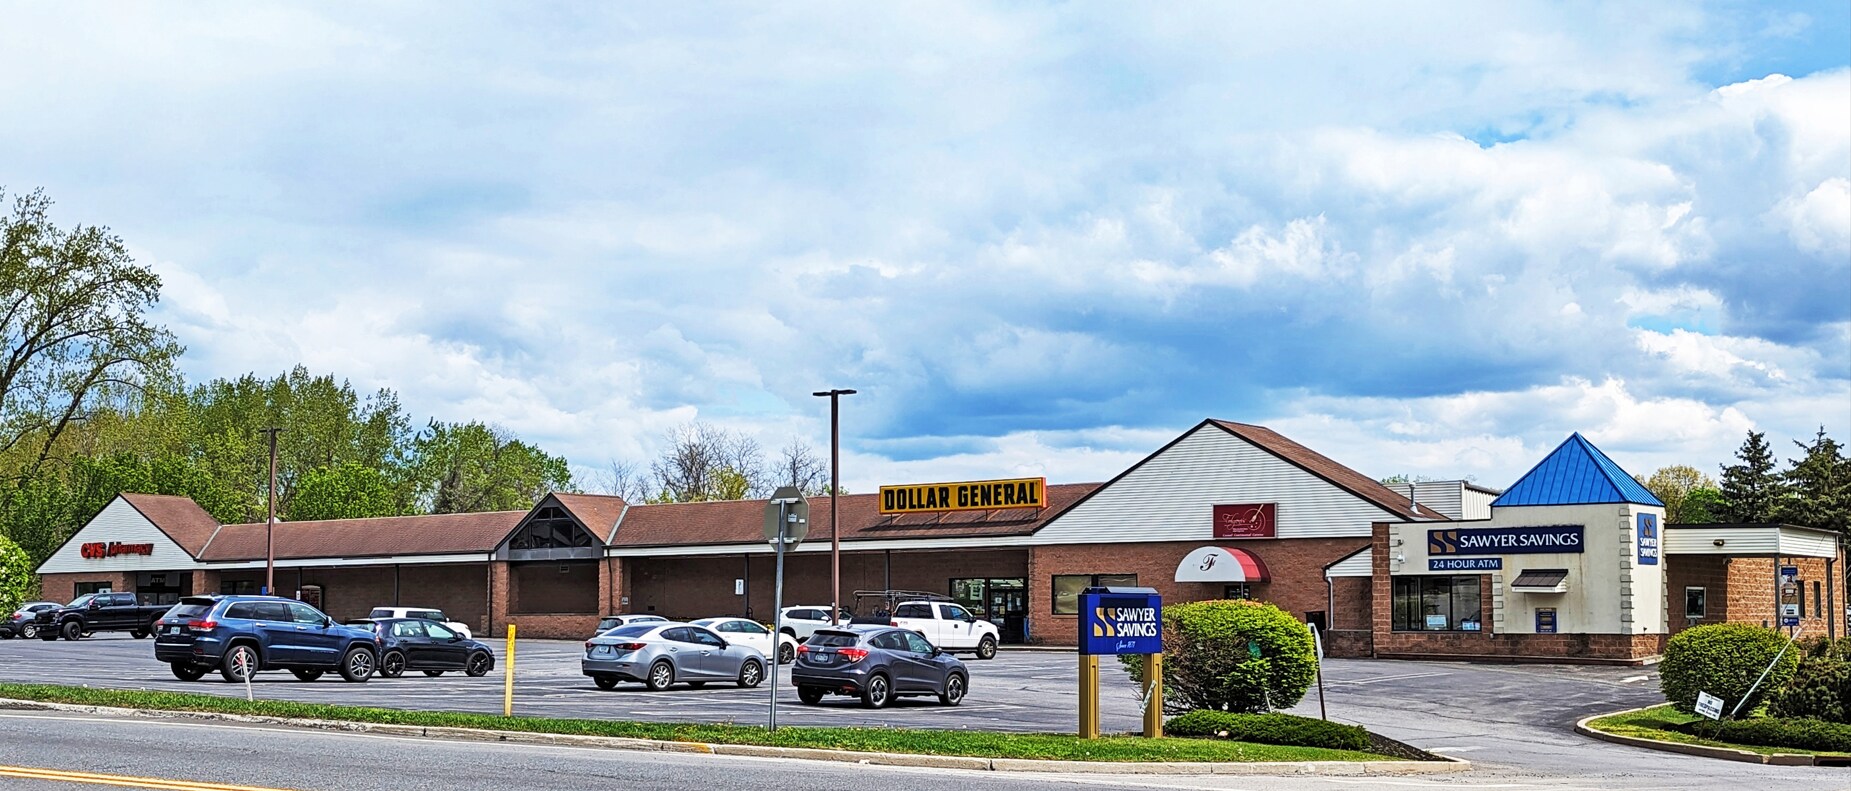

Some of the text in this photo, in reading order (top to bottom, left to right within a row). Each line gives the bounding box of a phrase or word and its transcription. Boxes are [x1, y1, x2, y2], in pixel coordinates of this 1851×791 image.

[884, 482, 1038, 510] DOLLAR GENERAL
[1460, 533, 1579, 548] SAWYER SAVINGS
[1640, 537, 1657, 547] SAWYER
[81, 543, 106, 558] CVS
[1433, 559, 1498, 569] 24 HOUR ATM
[1117, 607, 1156, 621] SAWYER
[1117, 622, 1157, 636] SAVINGS
